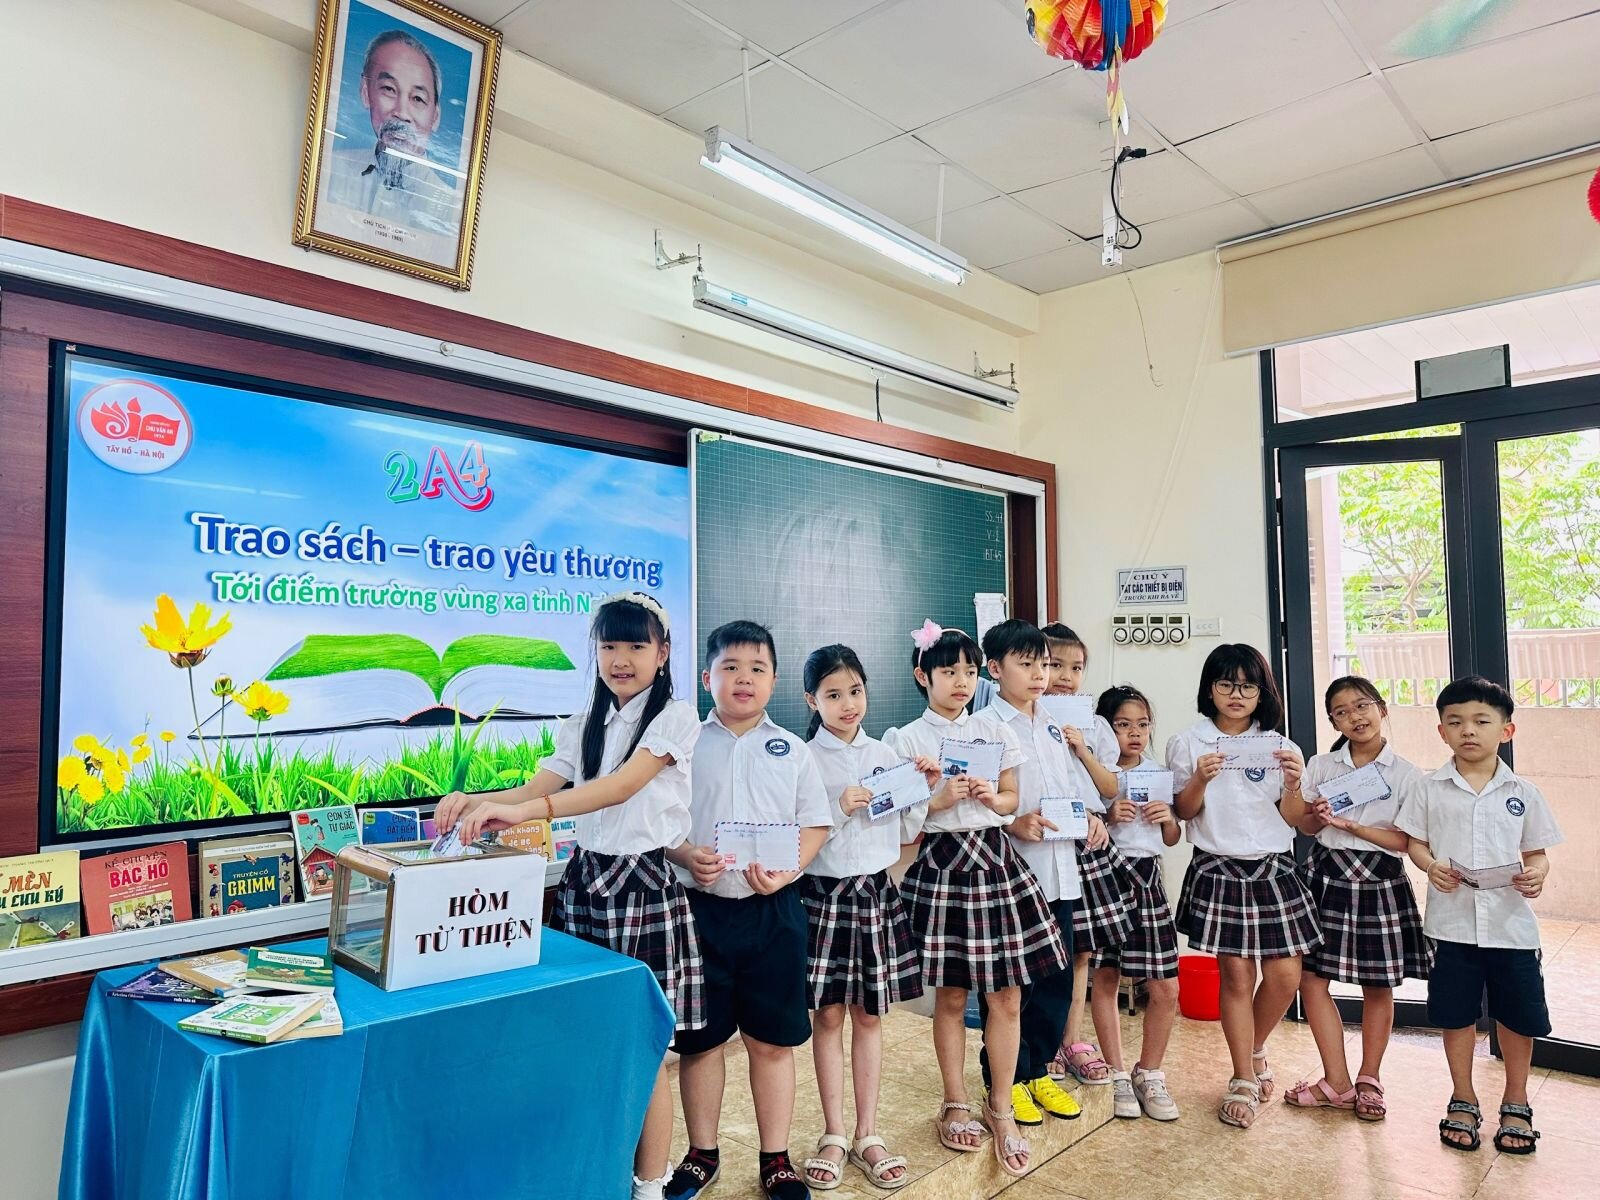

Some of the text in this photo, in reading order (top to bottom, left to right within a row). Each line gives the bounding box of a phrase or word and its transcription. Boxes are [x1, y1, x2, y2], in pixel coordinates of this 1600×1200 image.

[383, 439, 494, 512] 2A4
[198, 514, 291, 557] Trao
[303, 525, 387, 563] sách
[428, 538, 496, 571] trao
[504, 543, 556, 579] yêu
[564, 547, 661, 588] thương
[1133, 571, 1169, 581] CHÚ Ý
[215, 573, 261, 602] Tới
[270, 573, 340, 605] điểm
[347, 582, 437, 613] trường
[444, 590, 498, 615] vùng
[504, 597, 526, 612] xa
[533, 590, 572, 614] tỉnh
[1132, 581, 1144, 593] CÁC
[1144, 579, 1160, 593] THIẾT
[1161, 582, 1168, 594] BỊ
[1168, 579, 1183, 593] ĐIỆN
[1124, 593, 1147, 601] TRƯỚC
[327, 810, 343, 822] CON
[328, 820, 356, 833] TỰ GIÁC
[109, 866, 143, 889] BÁC
[233, 870, 259, 879] TRUYỆN
[44, 885, 64, 903] KÝ
[227, 875, 276, 897] GRIMM
[448, 887, 510, 918] HÒM
[415, 916, 535, 955] TỪ THIỆN
